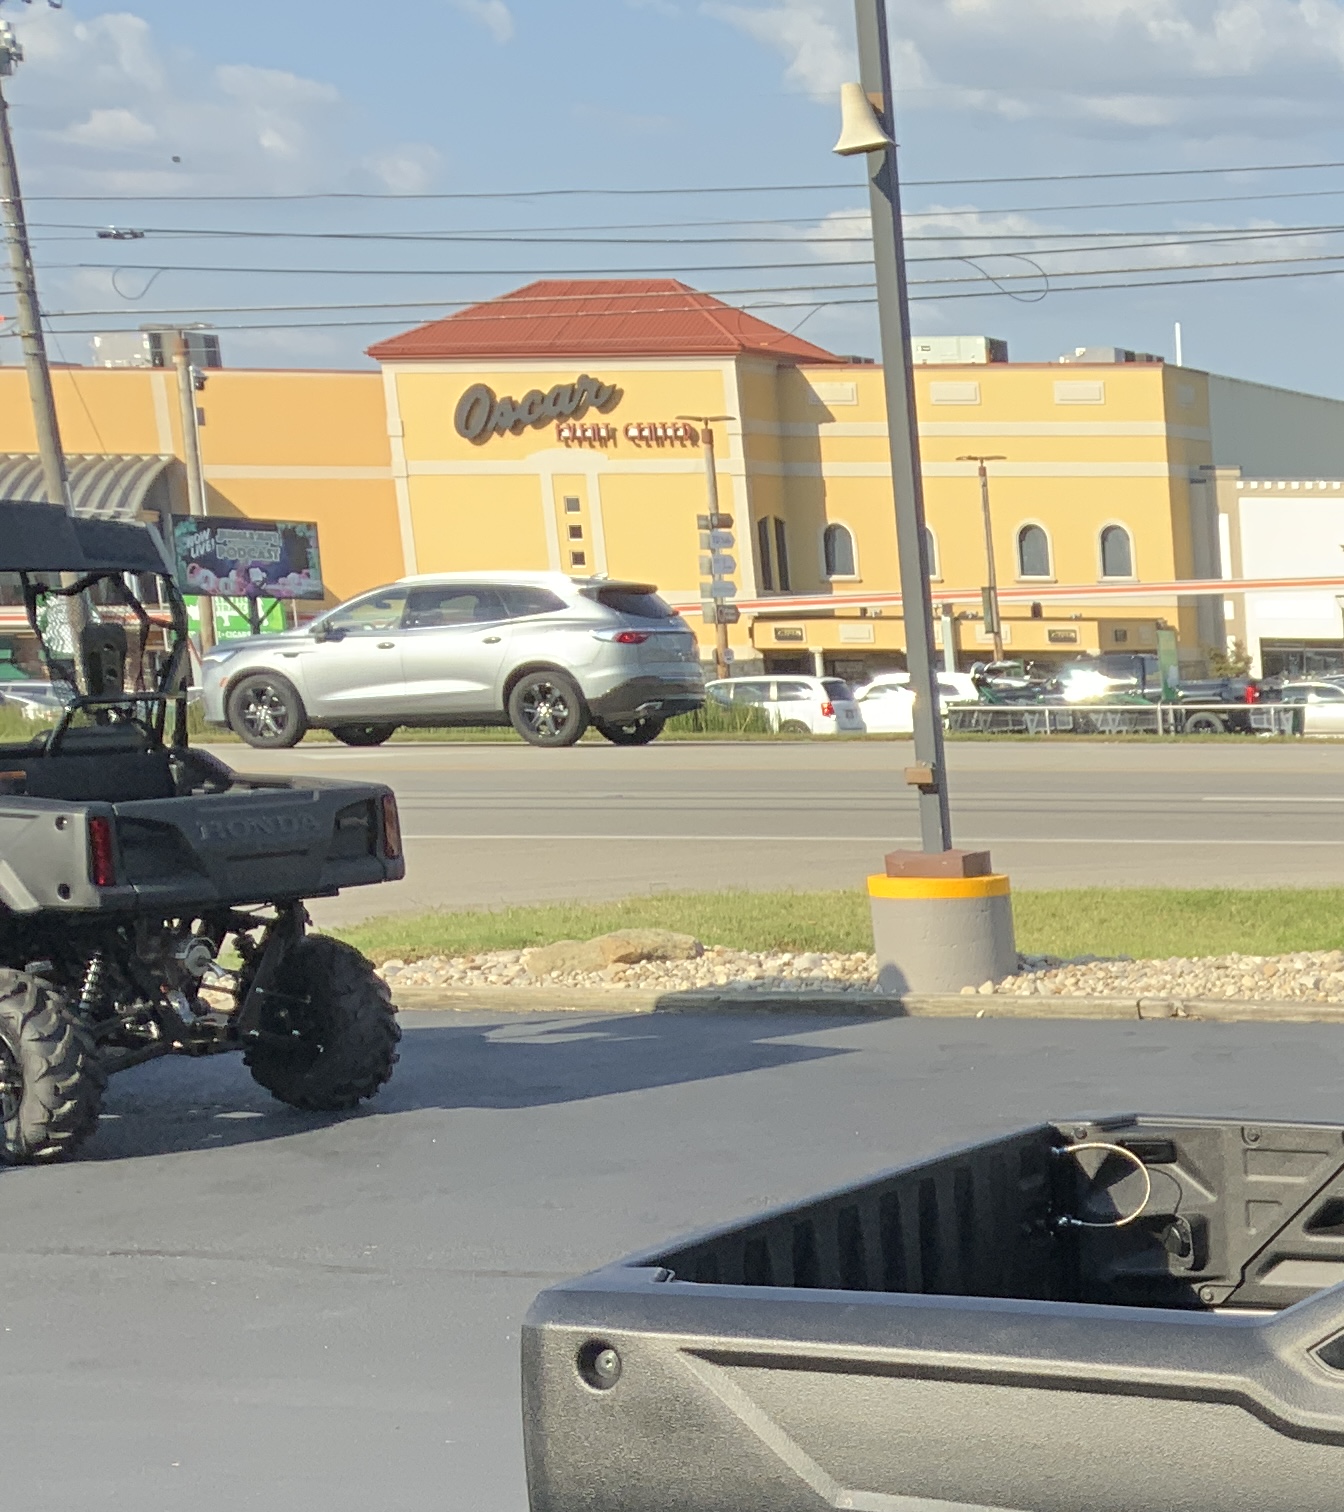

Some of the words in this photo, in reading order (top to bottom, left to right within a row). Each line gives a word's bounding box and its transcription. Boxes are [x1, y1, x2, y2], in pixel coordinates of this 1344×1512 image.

[454, 374, 620, 442] Oscar
[556, 422, 612, 445] EVENT
[623, 421, 694, 445] CENTER
[186, 528, 211, 548] NOW
[191, 538, 215, 559] LIVE!
[217, 545, 281, 561] PODCAST
[196, 811, 321, 841] HONDA
